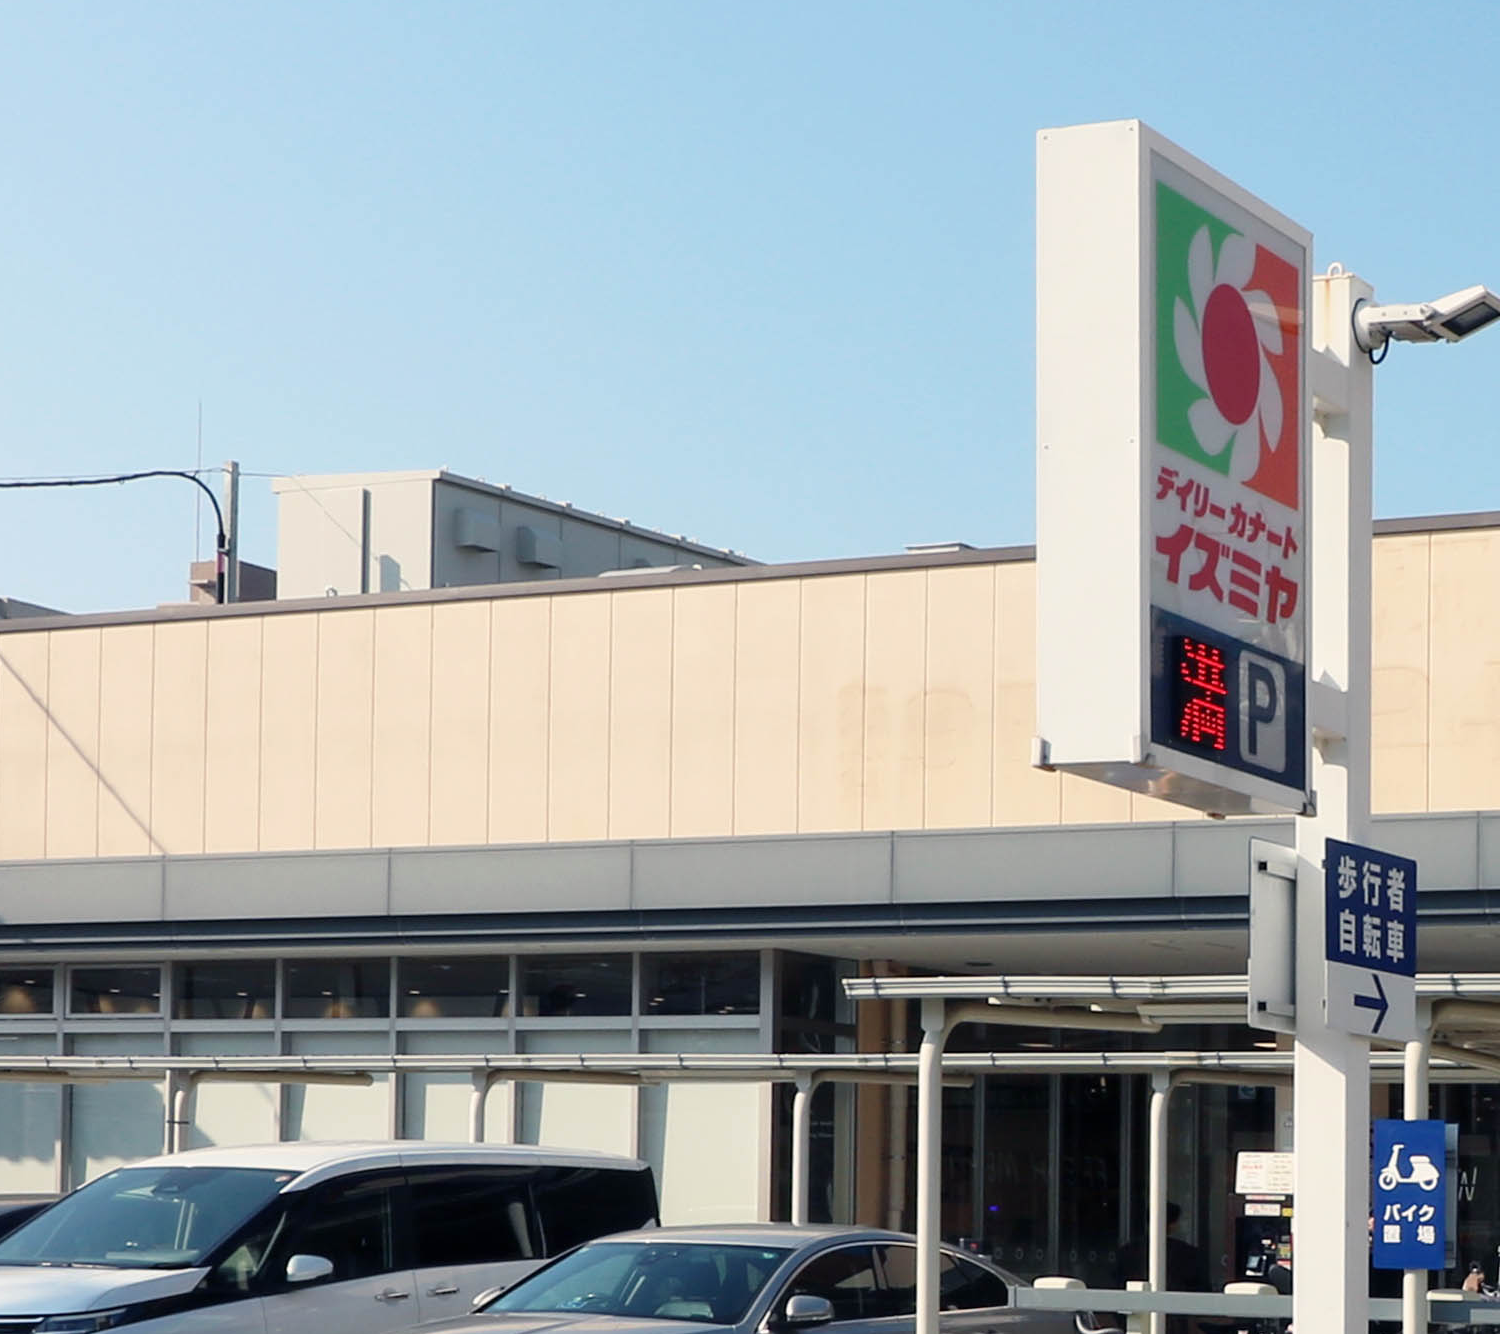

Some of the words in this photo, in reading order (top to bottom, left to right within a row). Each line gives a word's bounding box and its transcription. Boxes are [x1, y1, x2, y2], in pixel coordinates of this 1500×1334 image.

[1156, 466, 1298, 560] デイリーカナート
[1156, 524, 1298, 624] イズミヤ
[1248, 661, 1277, 757] P
[1338, 855, 1405, 913] 歩行者
[1339, 908, 1405, 963] 自転車
[1383, 1204, 1435, 1222] バイク
